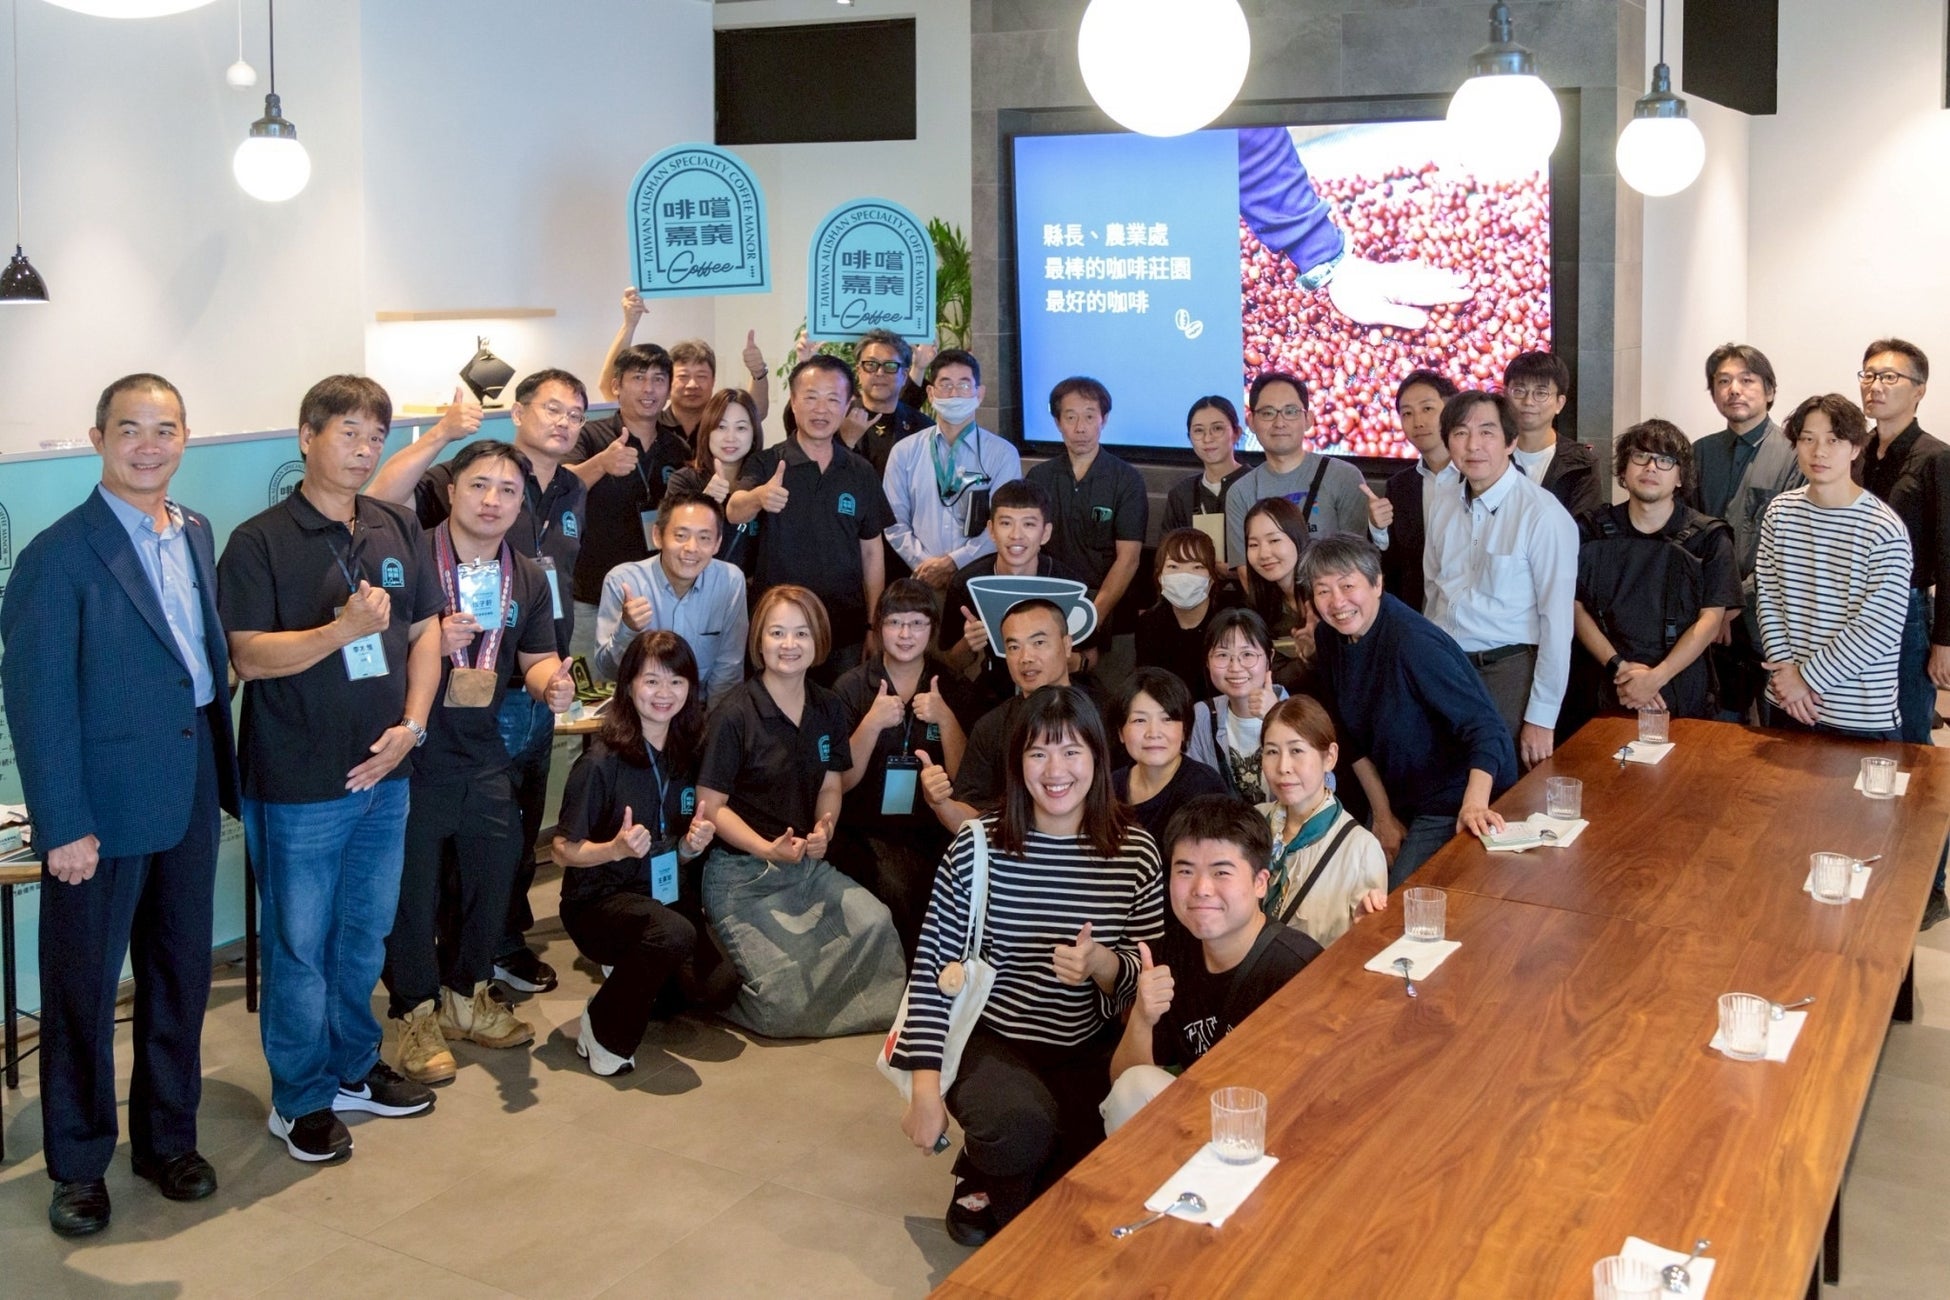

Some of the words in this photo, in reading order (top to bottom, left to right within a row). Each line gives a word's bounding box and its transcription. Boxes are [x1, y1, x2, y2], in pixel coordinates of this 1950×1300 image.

[669, 155, 730, 174] SPECIALTY
[641, 167, 669, 215] ALISHAN
[728, 171, 753, 212] COFFEE
[663, 197, 731, 220] 啡嚐
[850, 210, 905, 229] SPECIALTY
[641, 217, 654, 264] TAIWAN
[664, 223, 733, 248] 嘉義
[744, 214, 757, 260] MANOR
[821, 217, 850, 262] ALISHAN
[903, 227, 925, 267] COFFEE
[1042, 222, 1169, 248] 縣長、農業處
[666, 249, 735, 284] Coffee
[841, 249, 905, 271] 啡嚐
[1044, 256, 1192, 280] 最棒的咖啡莊園
[820, 264, 830, 308] TAIWAN
[841, 275, 905, 296] 嘉義
[914, 269, 925, 312] MANOR
[1045, 289, 1150, 313] 最好的咖啡
[840, 298, 904, 330] Coffee
